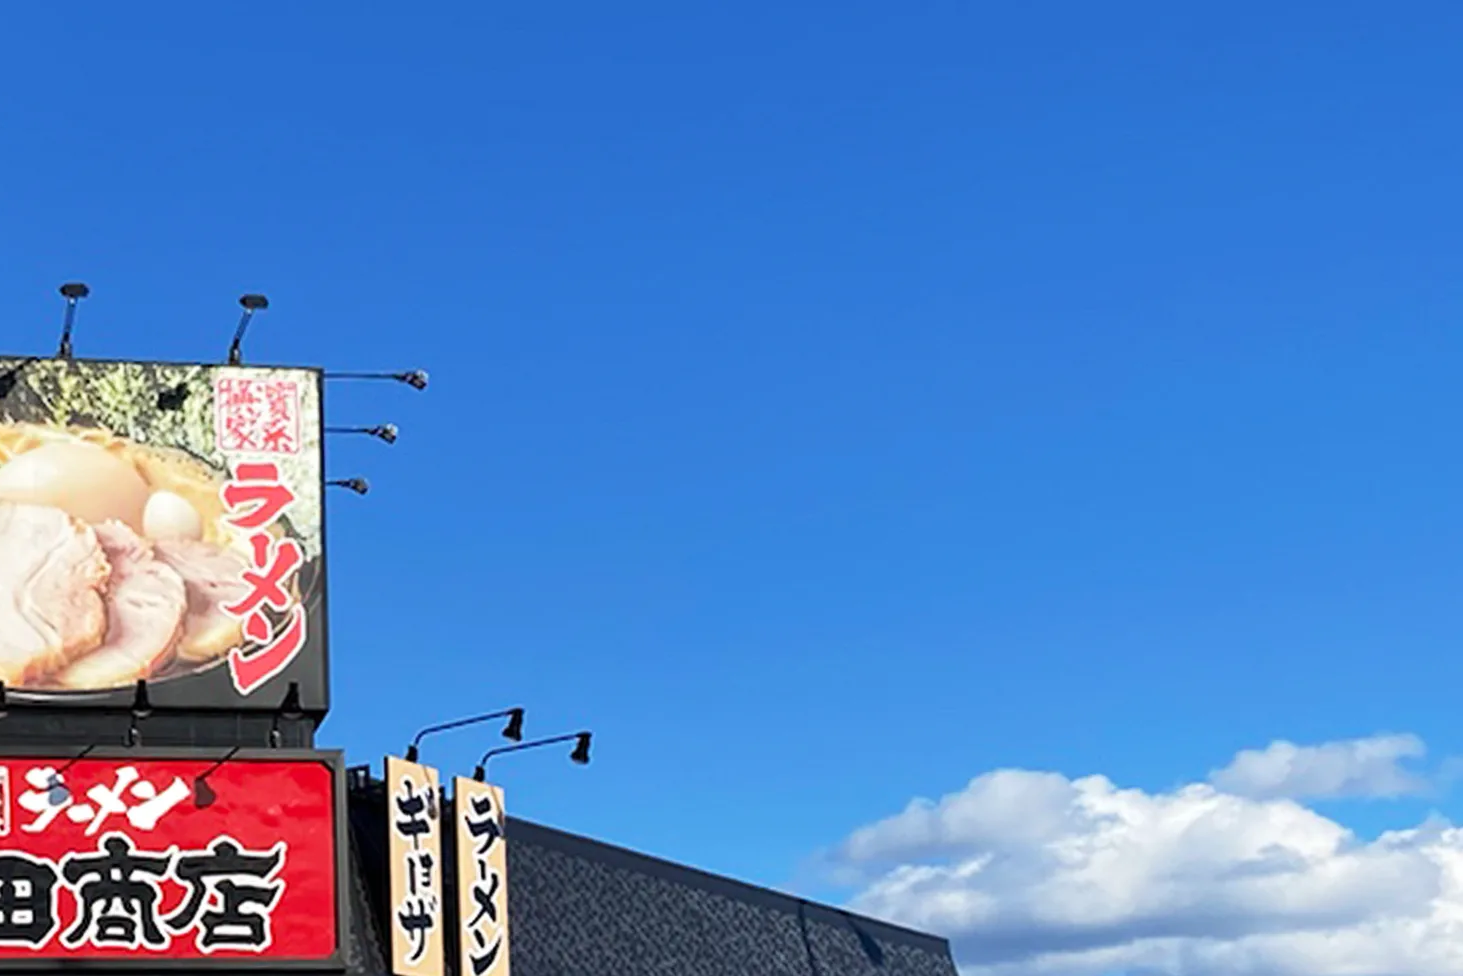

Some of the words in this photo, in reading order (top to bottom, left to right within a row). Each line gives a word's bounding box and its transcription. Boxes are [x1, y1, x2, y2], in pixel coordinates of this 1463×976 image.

[219, 463, 306, 694] ラーメン
[18, 766, 191, 836] ラーメン
[395, 776, 438, 966] ギョーザ
